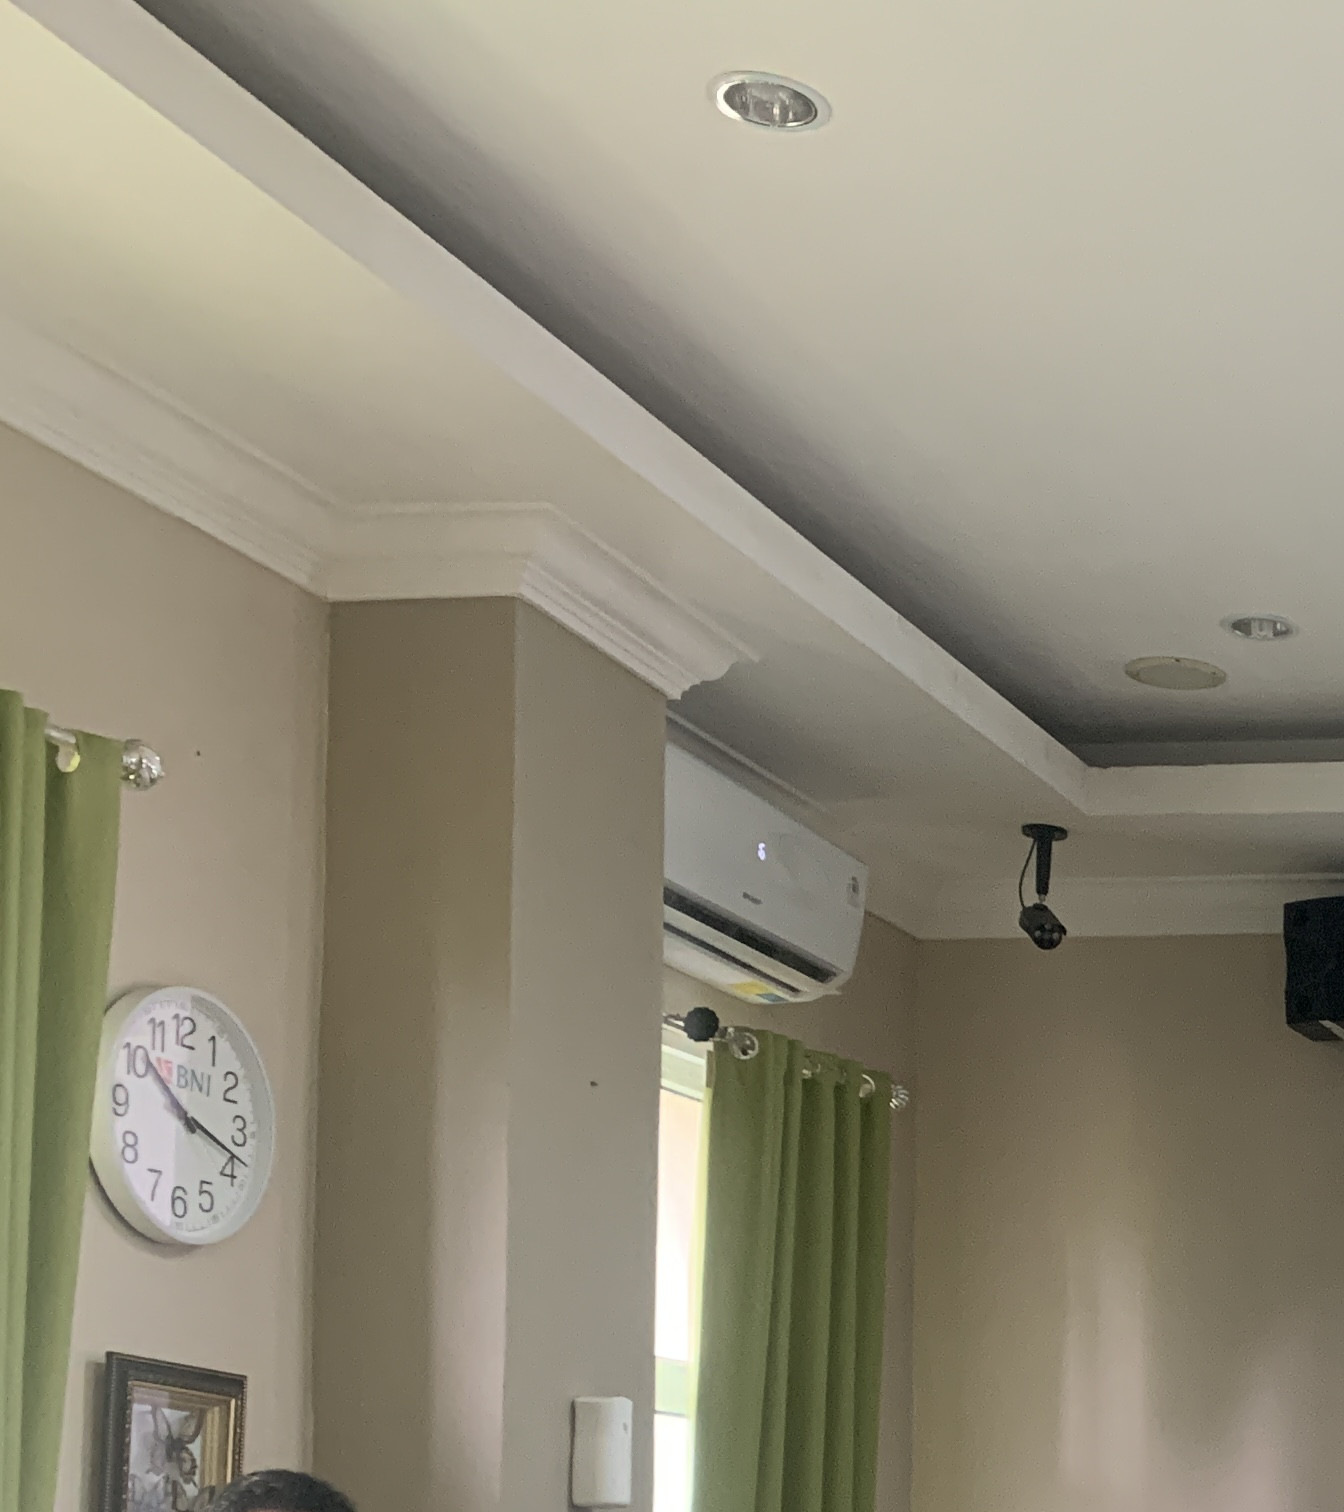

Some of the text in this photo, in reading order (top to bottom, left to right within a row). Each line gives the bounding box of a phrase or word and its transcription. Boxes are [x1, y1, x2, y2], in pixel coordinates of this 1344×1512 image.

[148, 1017, 165, 1053] 11
[172, 1013, 196, 1050] 12
[123, 1042, 150, 1078] 10
[208, 1035, 216, 1067] 1
[176, 1065, 211, 1097] BNI
[222, 1071, 239, 1104] 2
[112, 1084, 129, 1116] 9
[121, 1130, 138, 1164] 8
[231, 1115, 247, 1147] 3
[147, 1168, 162, 1201] 7
[220, 1155, 237, 1186] 4
[171, 1186, 188, 1218] 6
[199, 1180, 214, 1213] 5
